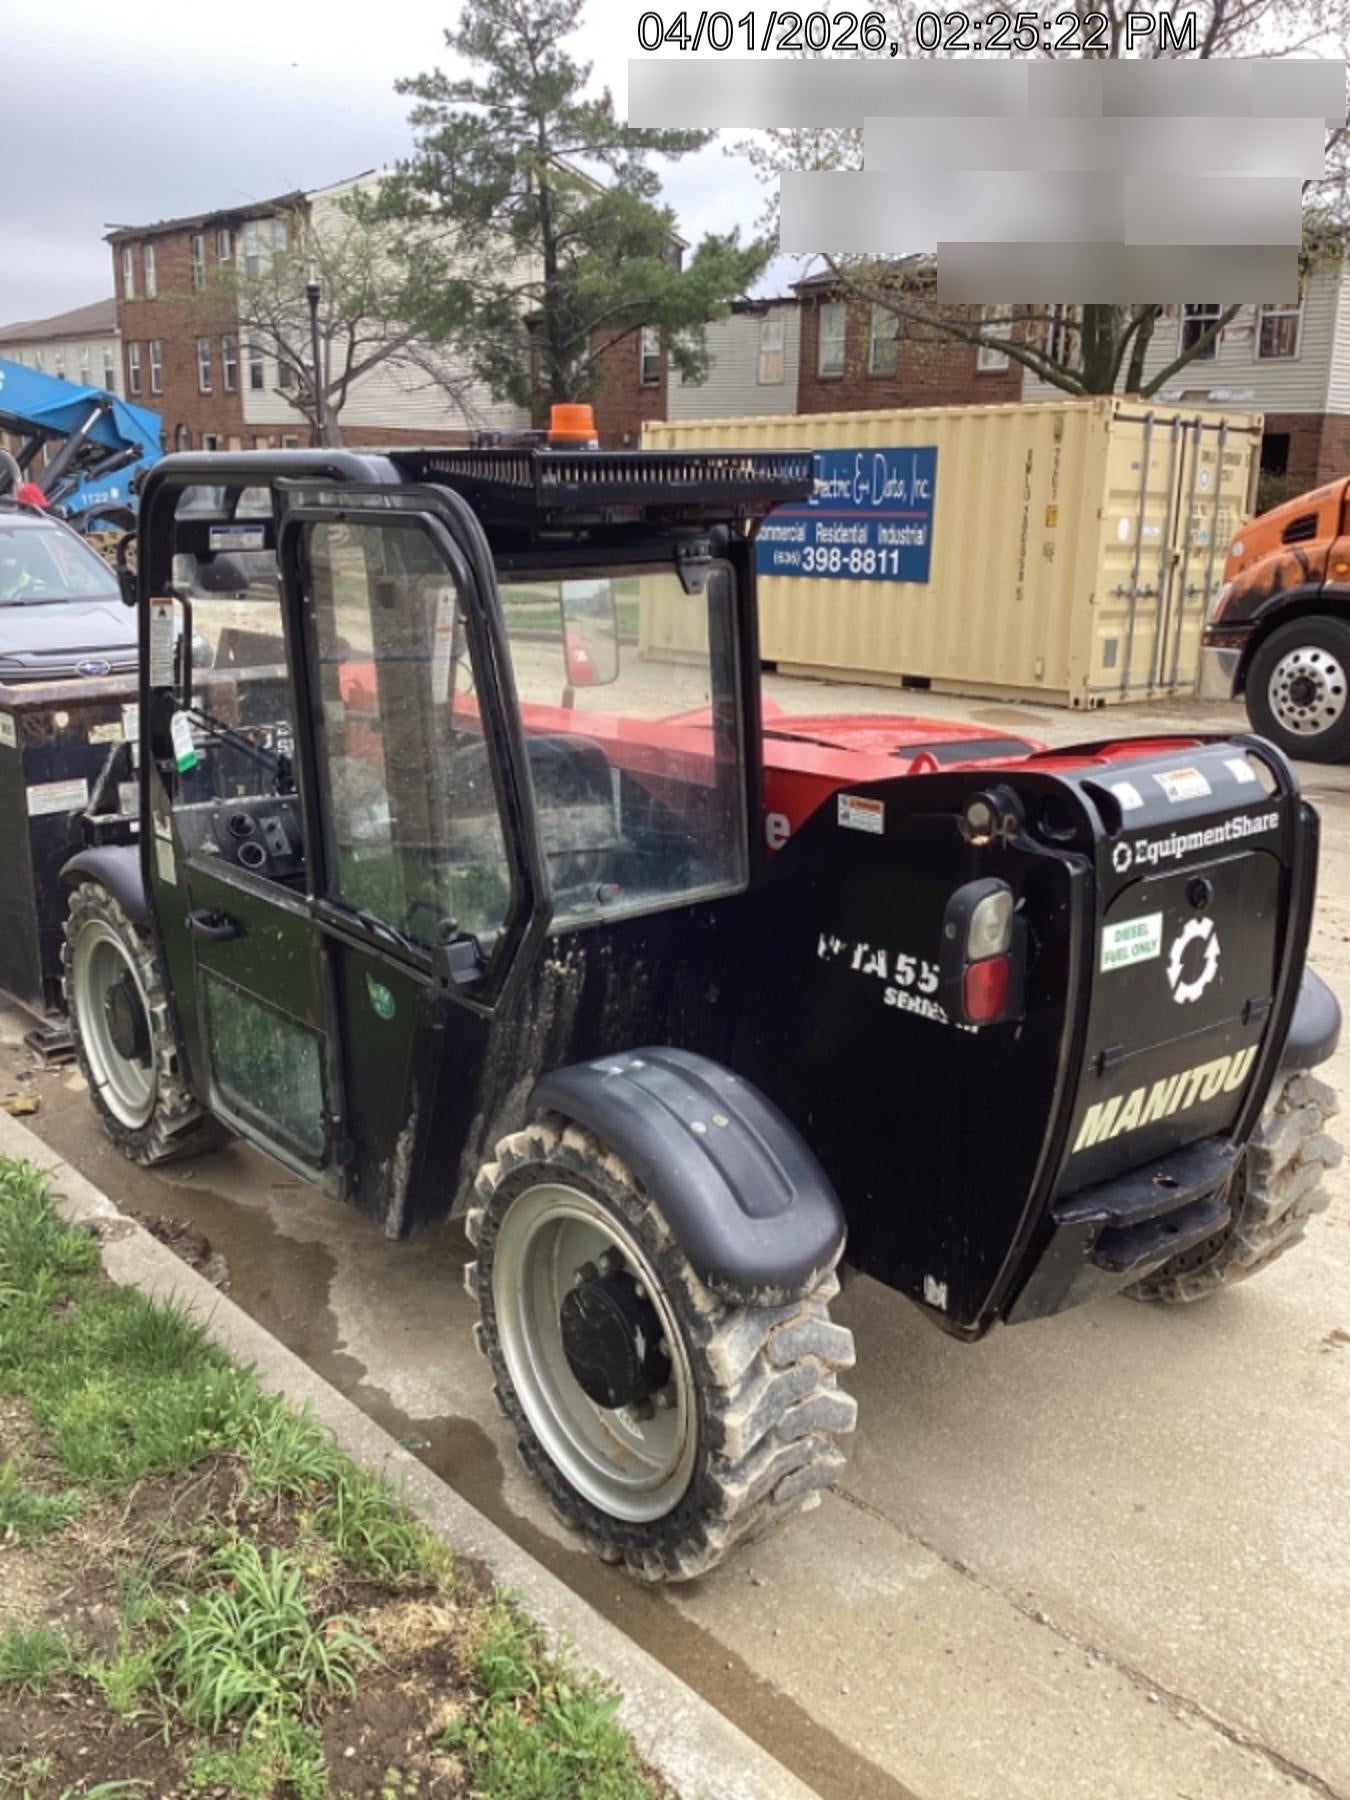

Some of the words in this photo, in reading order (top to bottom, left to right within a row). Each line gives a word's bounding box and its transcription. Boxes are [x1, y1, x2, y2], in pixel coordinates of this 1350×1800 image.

[816, 521, 868, 545] Residential
[877, 523, 927, 546] Industrial
[802, 546, 900, 575] 398-8811
[1135, 811, 1280, 865] EquipmentShare
[1114, 923, 1149, 943] DIESEL
[1104, 946, 1129, 965] FUEL
[1131, 938, 1158, 957] ONLY
[1072, 1043, 1259, 1155] MANITOU
